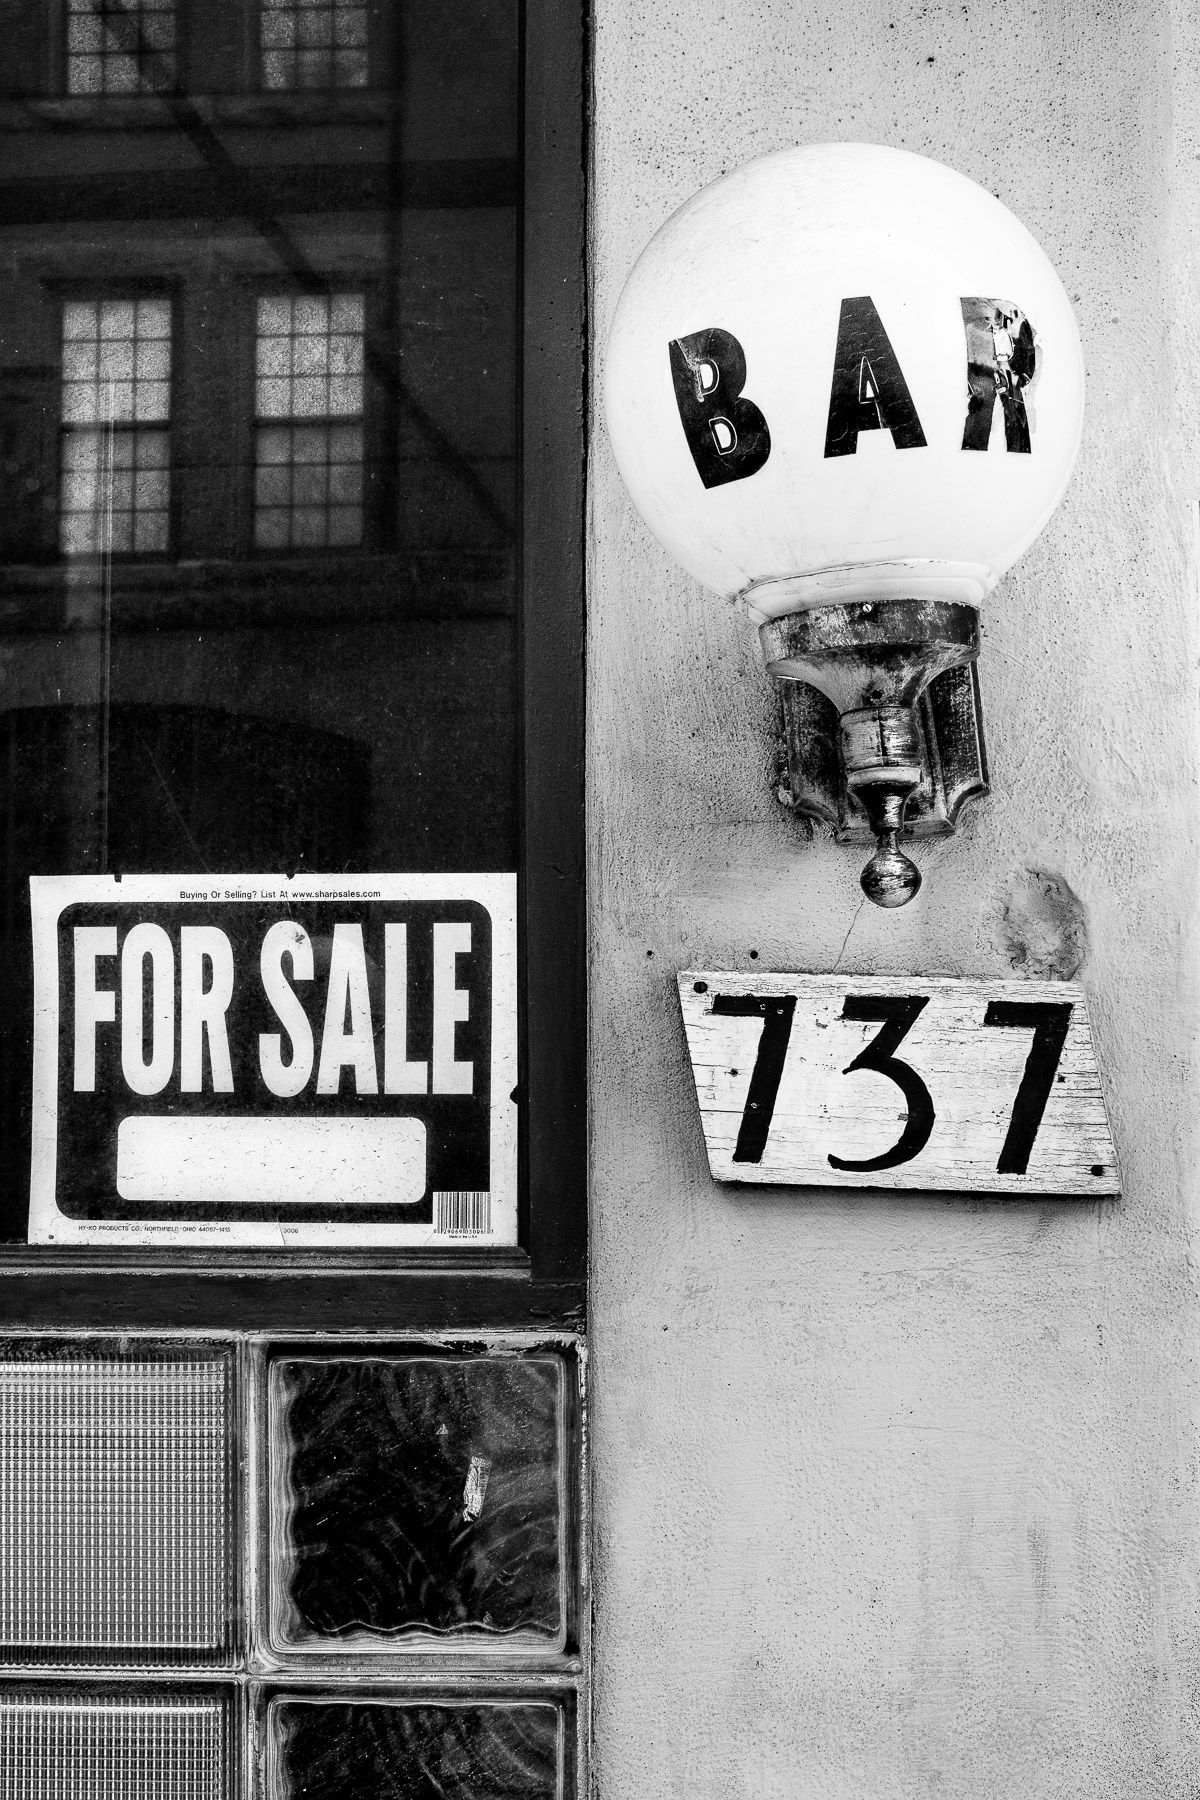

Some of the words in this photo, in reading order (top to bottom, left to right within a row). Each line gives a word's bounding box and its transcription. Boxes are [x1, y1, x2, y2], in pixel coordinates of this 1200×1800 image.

[667, 295, 1037, 490] BAR
[179, 890, 208, 900] Buying
[210, 890, 221, 899] Or
[224, 890, 257, 900] Selling?
[260, 890, 276, 899] List
[279, 890, 288, 899] At
[291, 889, 381, 899] www.sharpsales.com
[73, 922, 235, 1096] FOR
[258, 920, 474, 1098] SALE
[707, 993, 1074, 1175] 737
